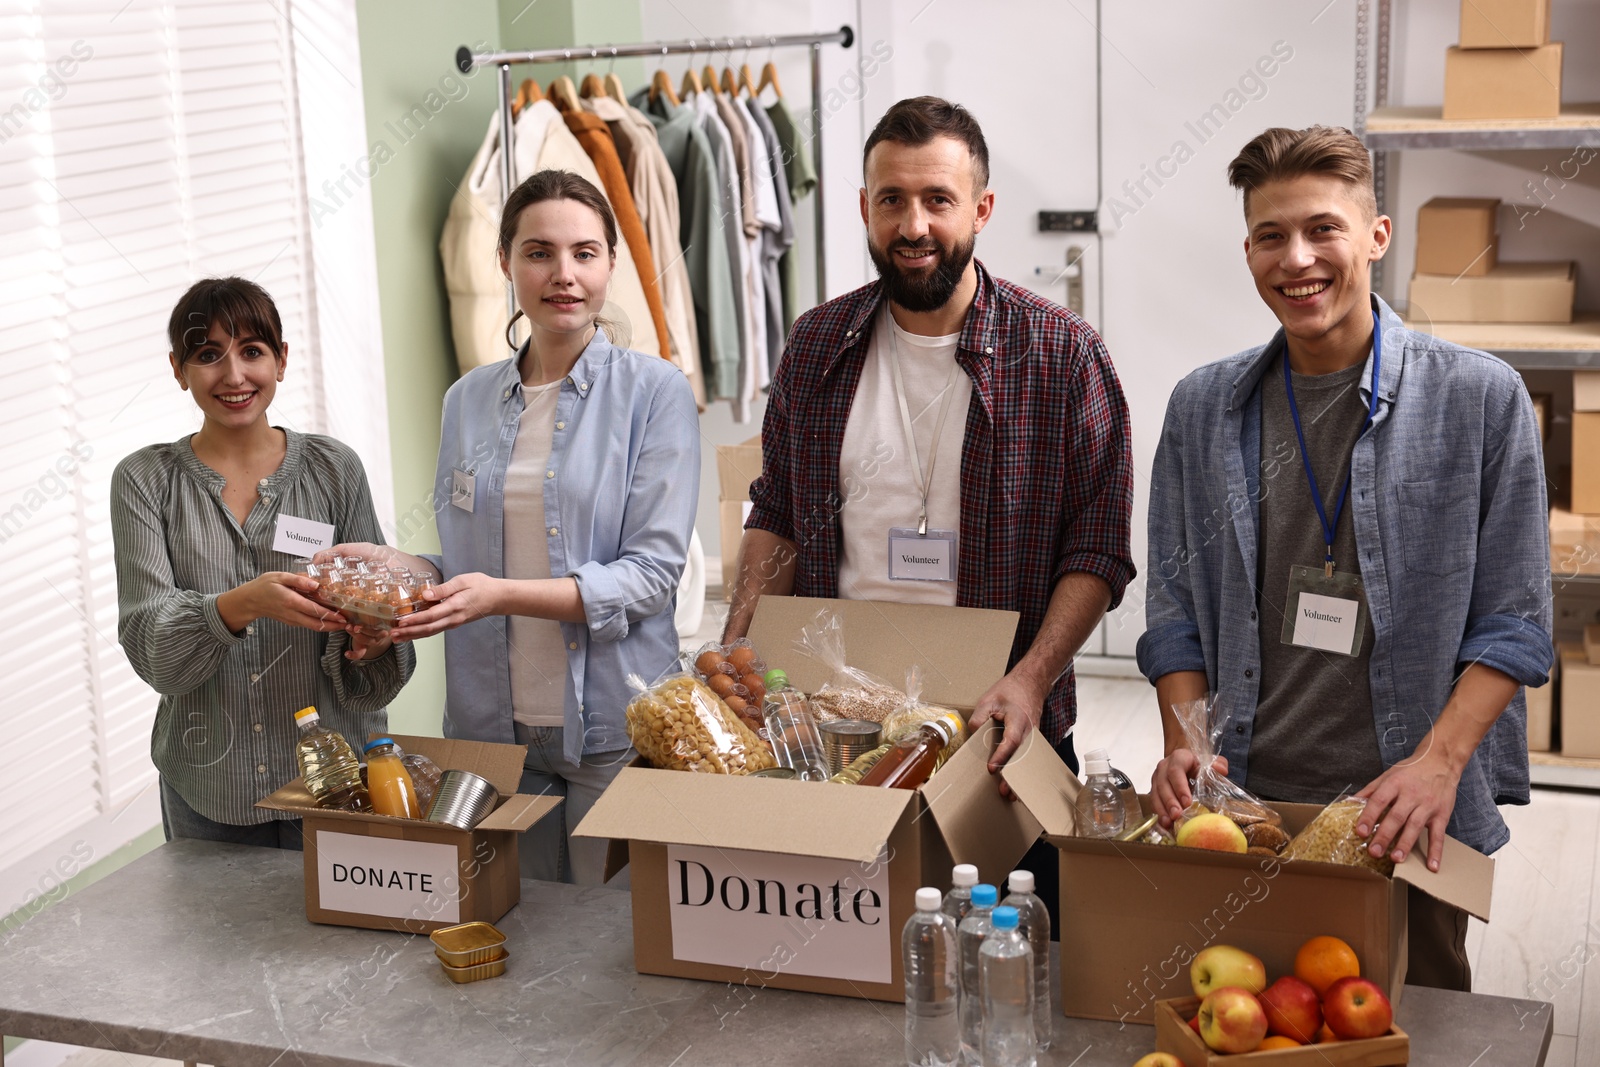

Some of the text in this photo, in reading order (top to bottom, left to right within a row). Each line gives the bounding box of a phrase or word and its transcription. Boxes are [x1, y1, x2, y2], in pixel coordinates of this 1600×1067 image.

[286, 530, 323, 546] Volunteer
[902, 554, 940, 565] Volunteer
[1304, 608, 1342, 623] Volunteer
[333, 863, 433, 893] DONATE
[675, 859, 881, 925] Donate
